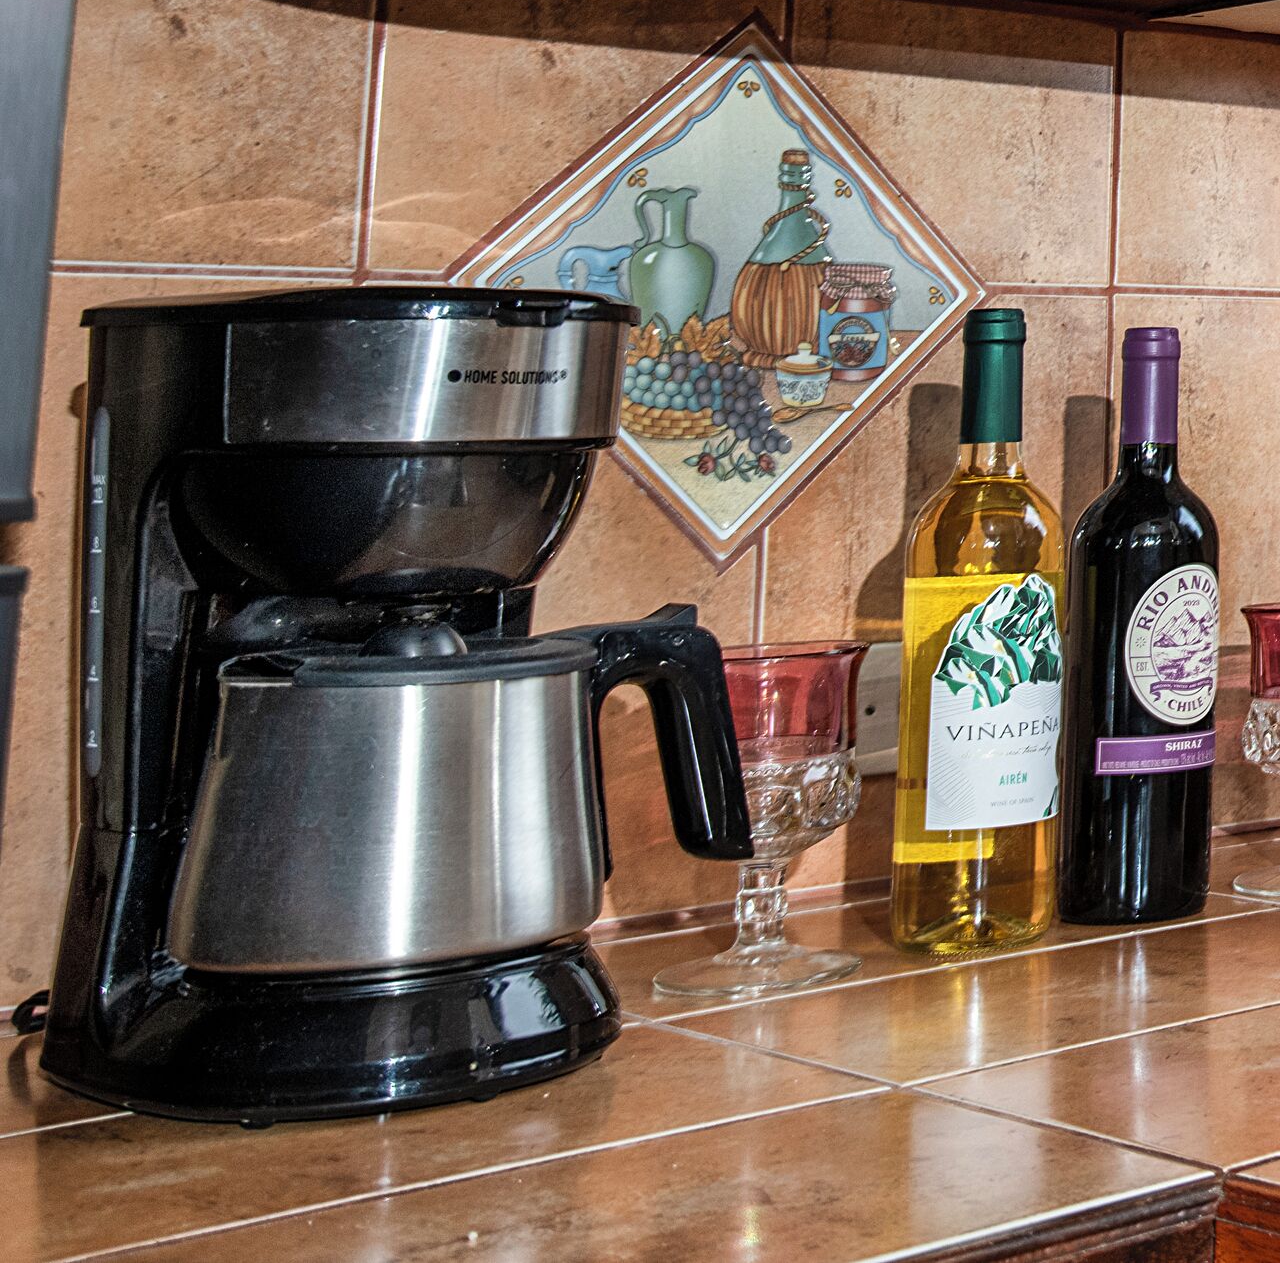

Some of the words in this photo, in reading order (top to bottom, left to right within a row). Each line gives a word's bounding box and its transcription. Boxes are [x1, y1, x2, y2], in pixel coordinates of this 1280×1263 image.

[464, 369, 498, 385] HOME
[92, 474, 106, 485] MAX
[93, 487, 103, 499] 10
[93, 536, 100, 549] 8
[92, 596, 98, 608] 6
[1183, 599, 1201, 607] 2023
[1136, 590, 1169, 631] RIO
[90, 665, 97, 677] 4
[1136, 661, 1149, 672] EST.
[1167, 694, 1204, 713] CHILE
[90, 730, 96, 743] 2
[1165, 738, 1204, 752] SHIRAZ
[998, 771, 1028, 787] AIRÉN
[991, 800, 1008, 808] WINE
